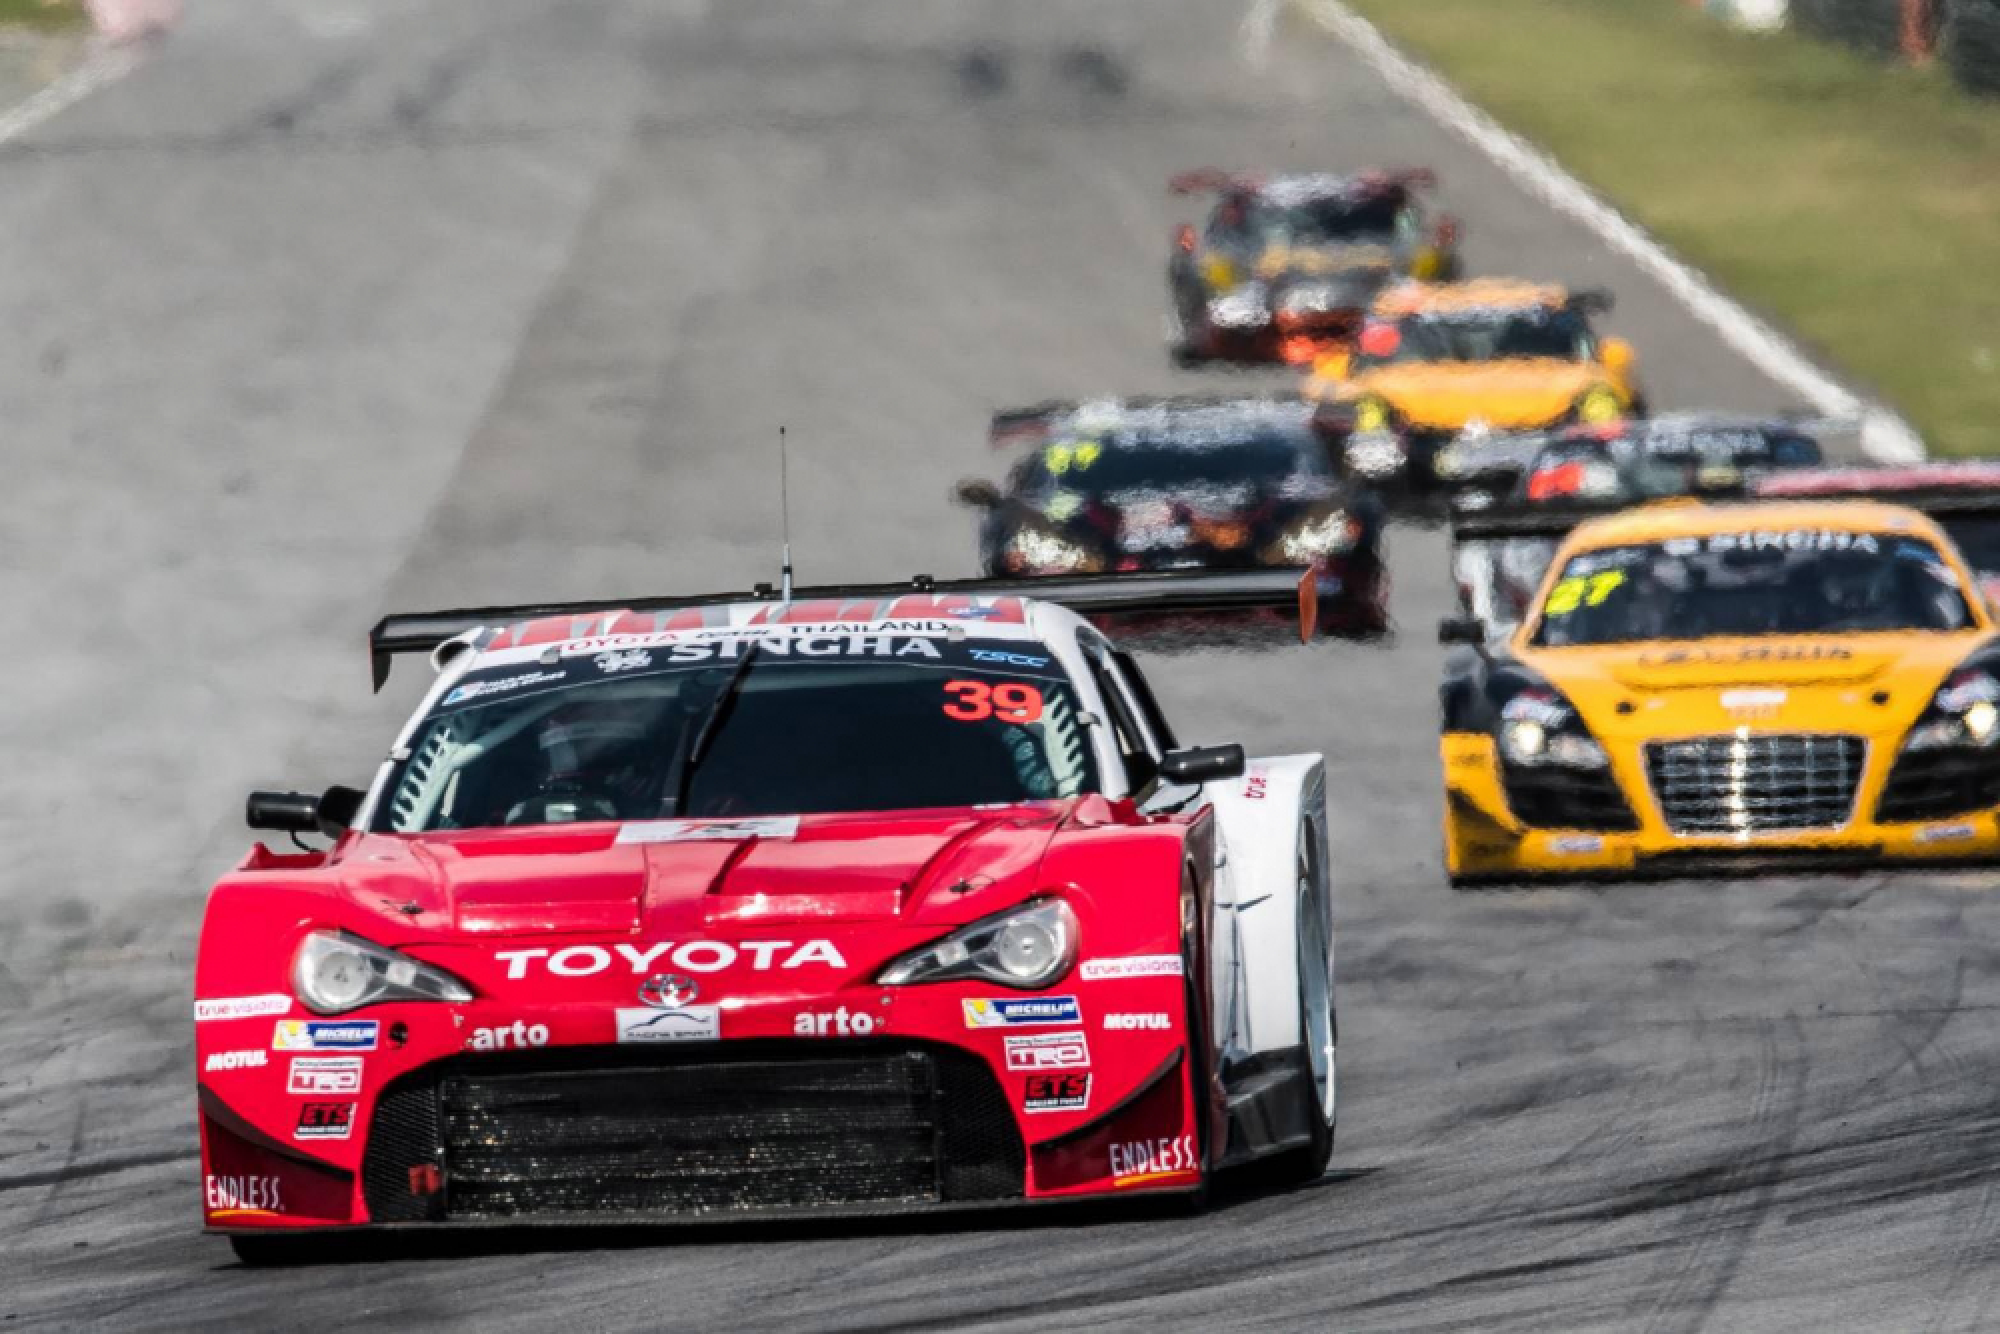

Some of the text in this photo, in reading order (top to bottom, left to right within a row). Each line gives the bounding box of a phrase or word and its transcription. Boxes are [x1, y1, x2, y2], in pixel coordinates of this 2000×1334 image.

[788, 621, 951, 635] THAILAND
[668, 634, 942, 662] SINGHA
[942, 679, 1043, 723] 39
[494, 939, 848, 980] TOYOTA
[472, 1020, 549, 1050] arto
[793, 1006, 873, 1036] arto
[1102, 1012, 1172, 1030] MOTUL
[205, 1049, 268, 1073] MOTUL
[1030, 1075, 1085, 1098] ETS
[1109, 1134, 1195, 1177] ENDLESS
[205, 1174, 282, 1210] ENDLESS
